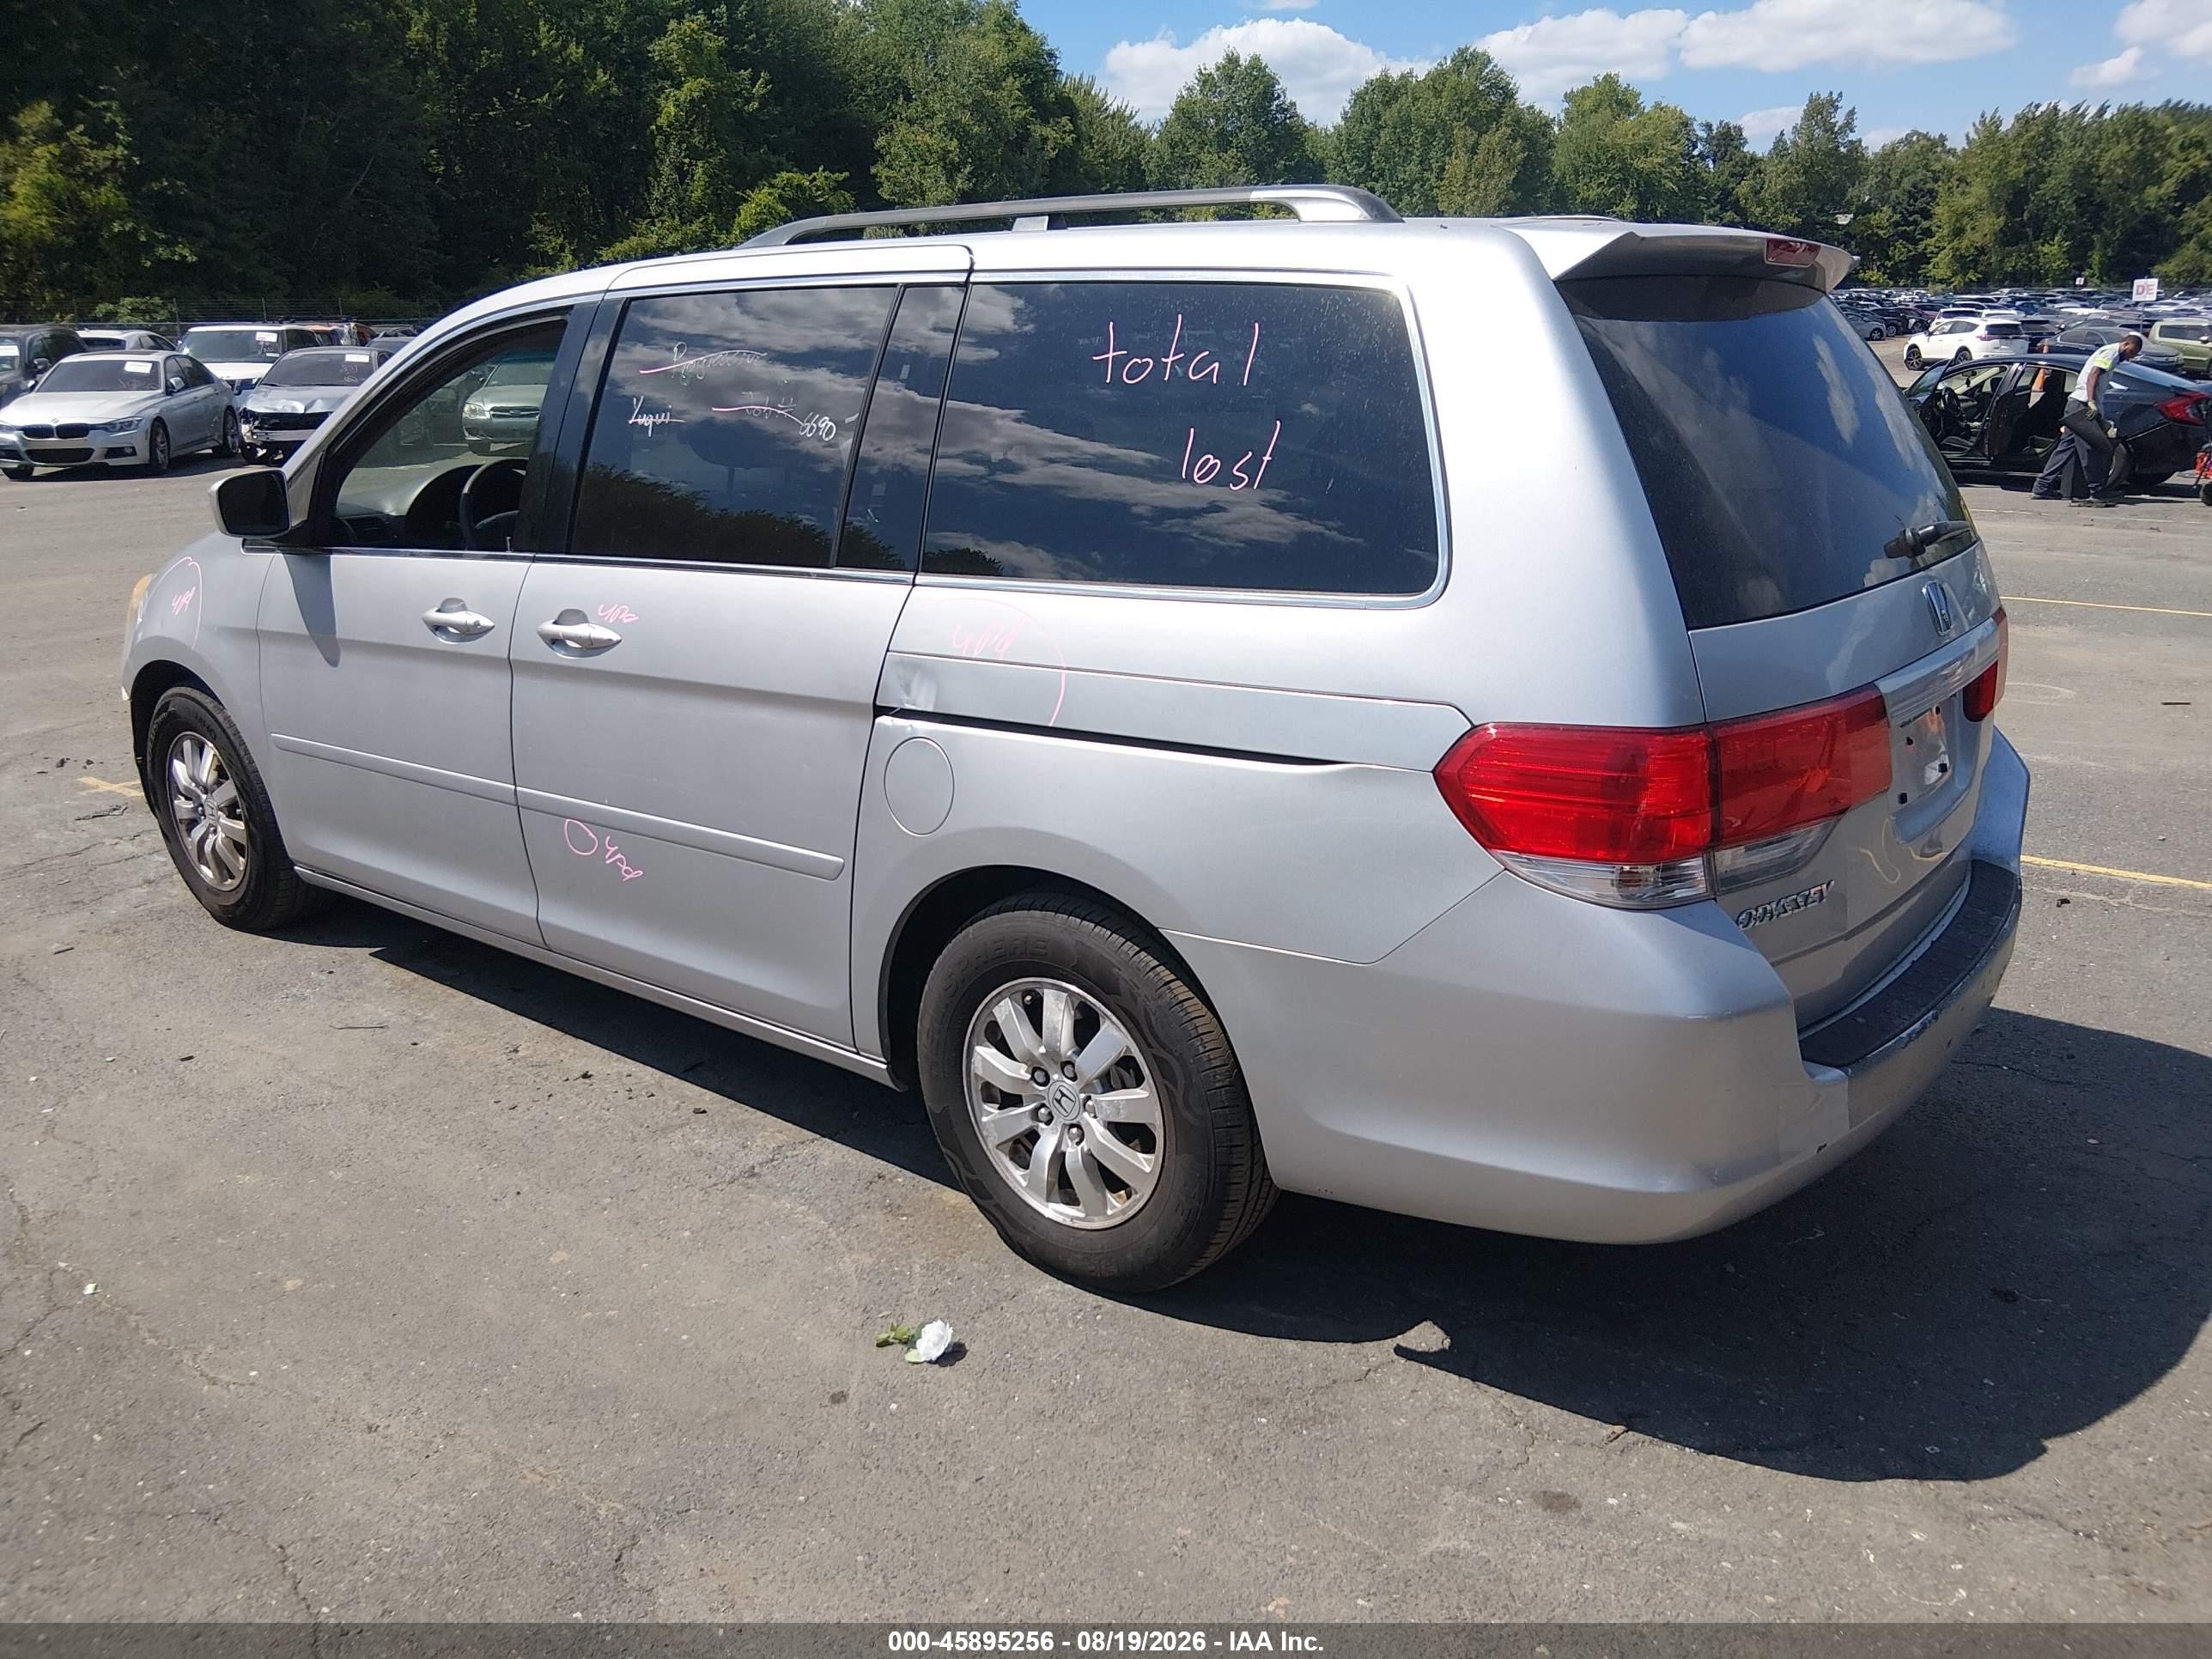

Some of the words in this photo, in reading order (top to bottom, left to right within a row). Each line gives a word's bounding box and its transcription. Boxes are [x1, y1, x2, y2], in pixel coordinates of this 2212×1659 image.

[1091, 313, 1260, 387] total
[798, 411, 836, 442] 6690
[1182, 419, 1283, 491] lost
